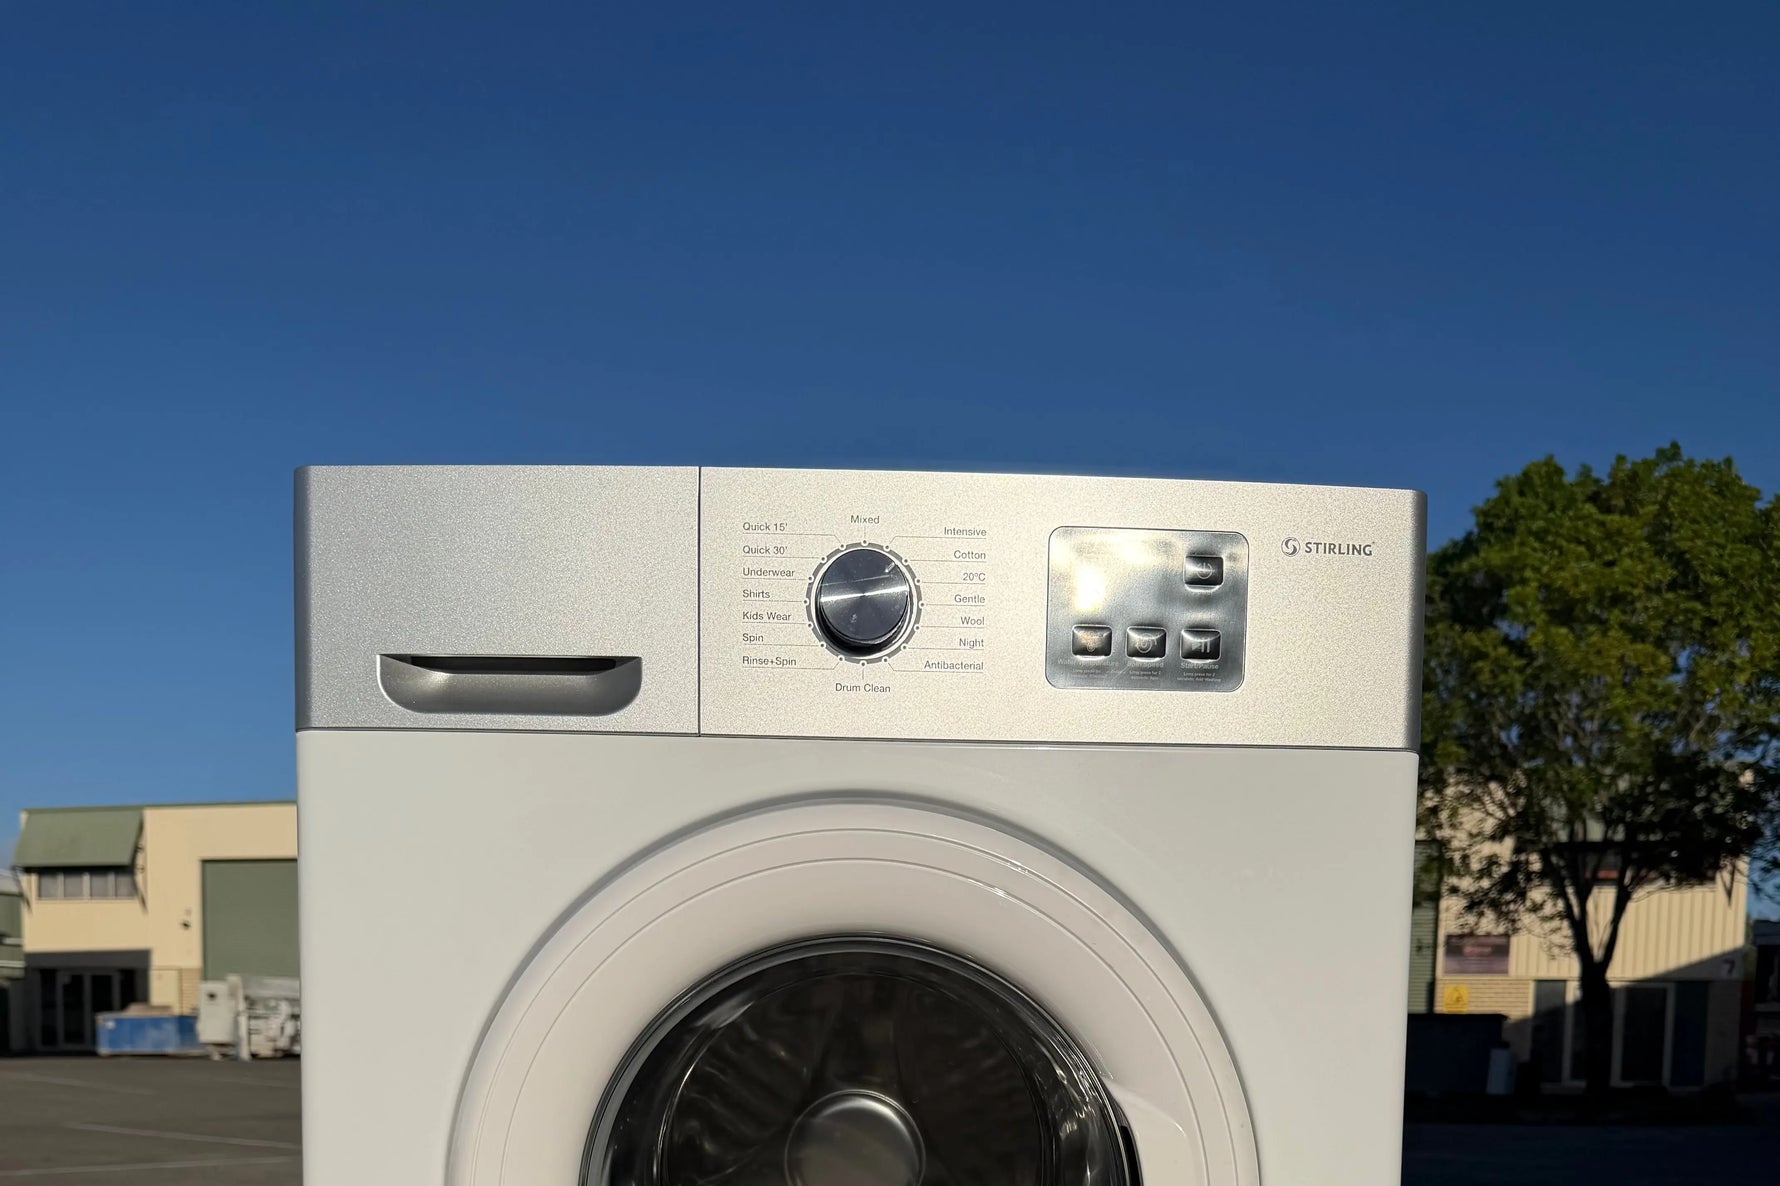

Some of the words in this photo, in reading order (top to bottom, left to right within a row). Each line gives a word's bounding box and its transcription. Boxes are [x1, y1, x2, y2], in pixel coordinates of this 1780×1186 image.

[851, 515, 880, 524] Mixed
[742, 522, 771, 532] Quick
[773, 522, 789, 532] 15'
[944, 527, 987, 536] Intensive
[742, 545, 771, 555] Quick
[773, 546, 789, 555] 30'
[1304, 541, 1373, 556] STIRLING
[953, 550, 987, 560] Cotton
[742, 567, 796, 577] Underwear
[742, 589, 771, 599] Shirts
[954, 594, 986, 604] Gentle
[742, 612, 764, 621] Kids
[766, 612, 792, 621] Wear
[960, 616, 985, 626] Wool
[742, 633, 764, 643] Spin
[959, 638, 985, 649] Night
[742, 656, 797, 667] Rinse+Spin
[924, 660, 984, 671] Antibacterial
[835, 683, 861, 692] Drum
[863, 684, 891, 693] Clean
